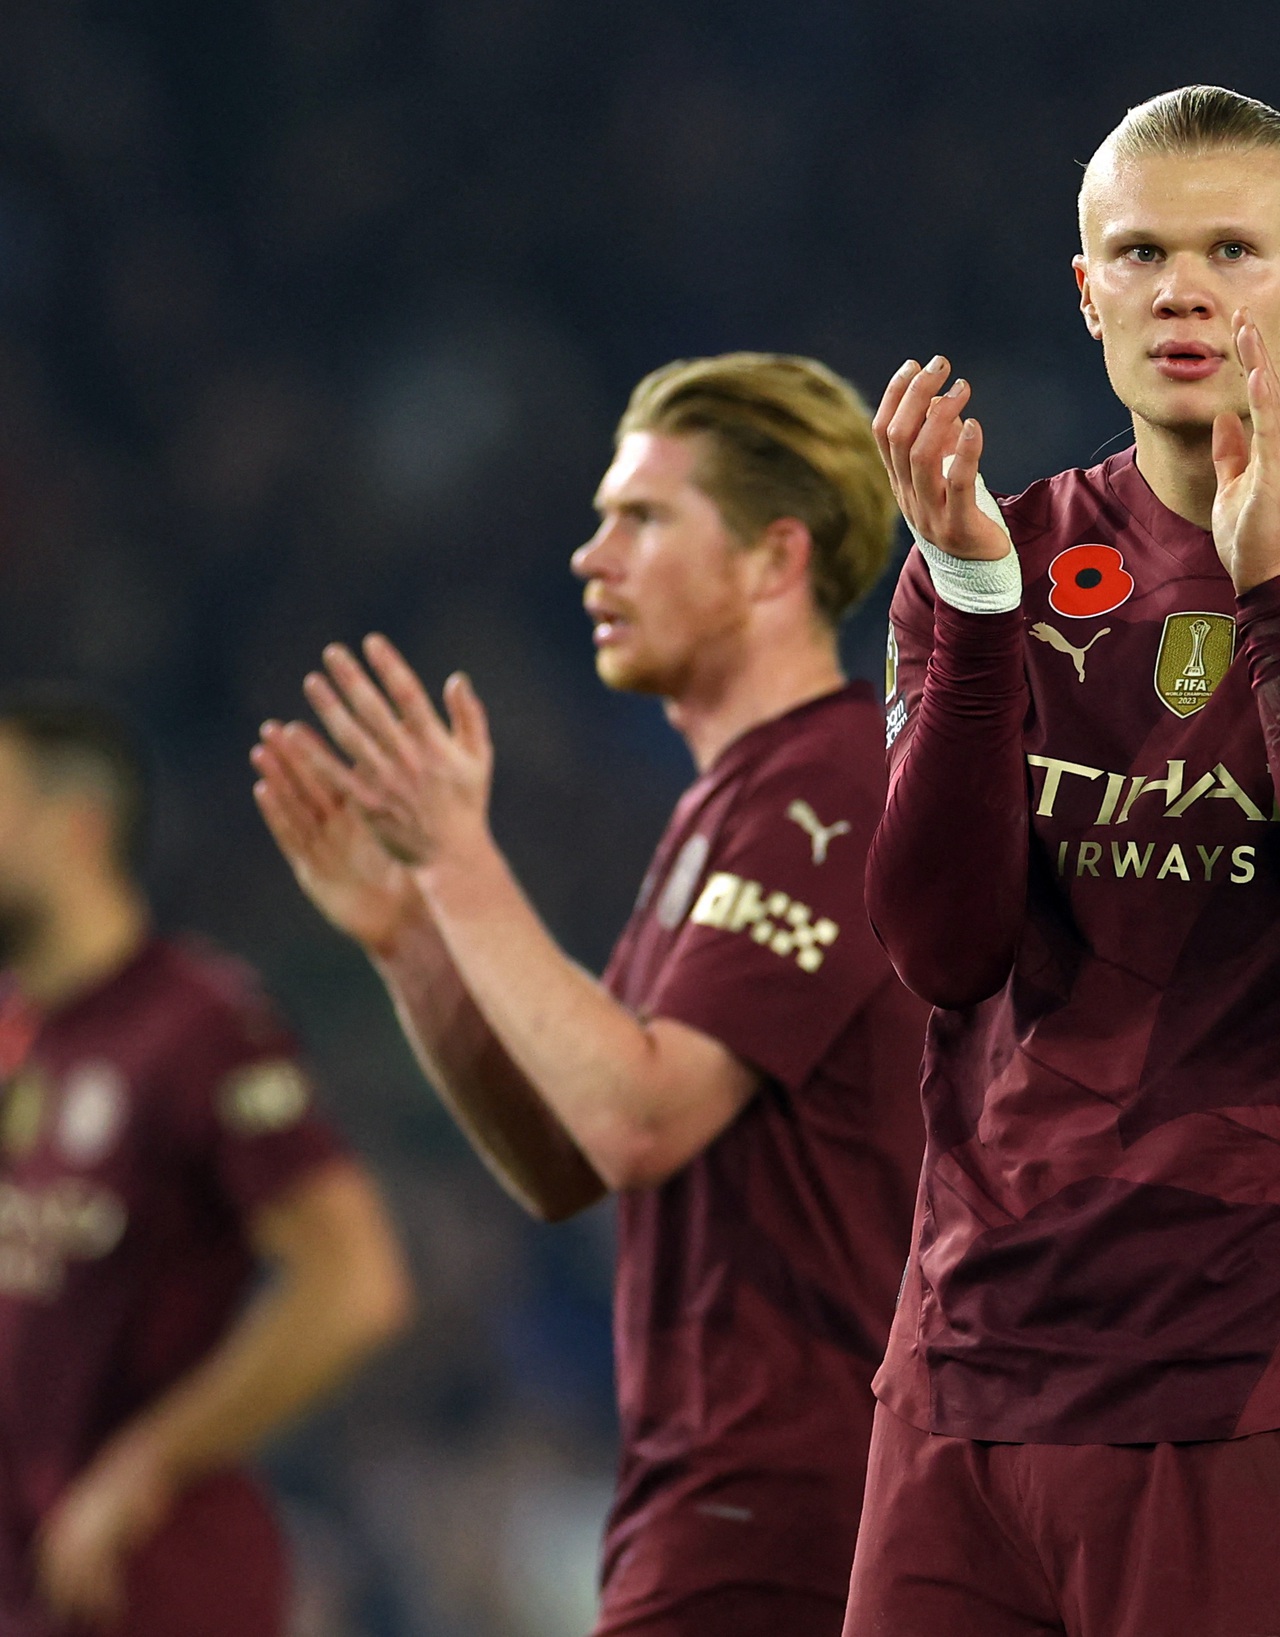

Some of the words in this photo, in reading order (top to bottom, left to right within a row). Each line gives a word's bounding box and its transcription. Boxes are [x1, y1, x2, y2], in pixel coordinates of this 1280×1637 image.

[1174, 678, 1207, 691] FIFA
[1178, 697, 1197, 705] 2023
[1057, 841, 1256, 884] IRWAYS
